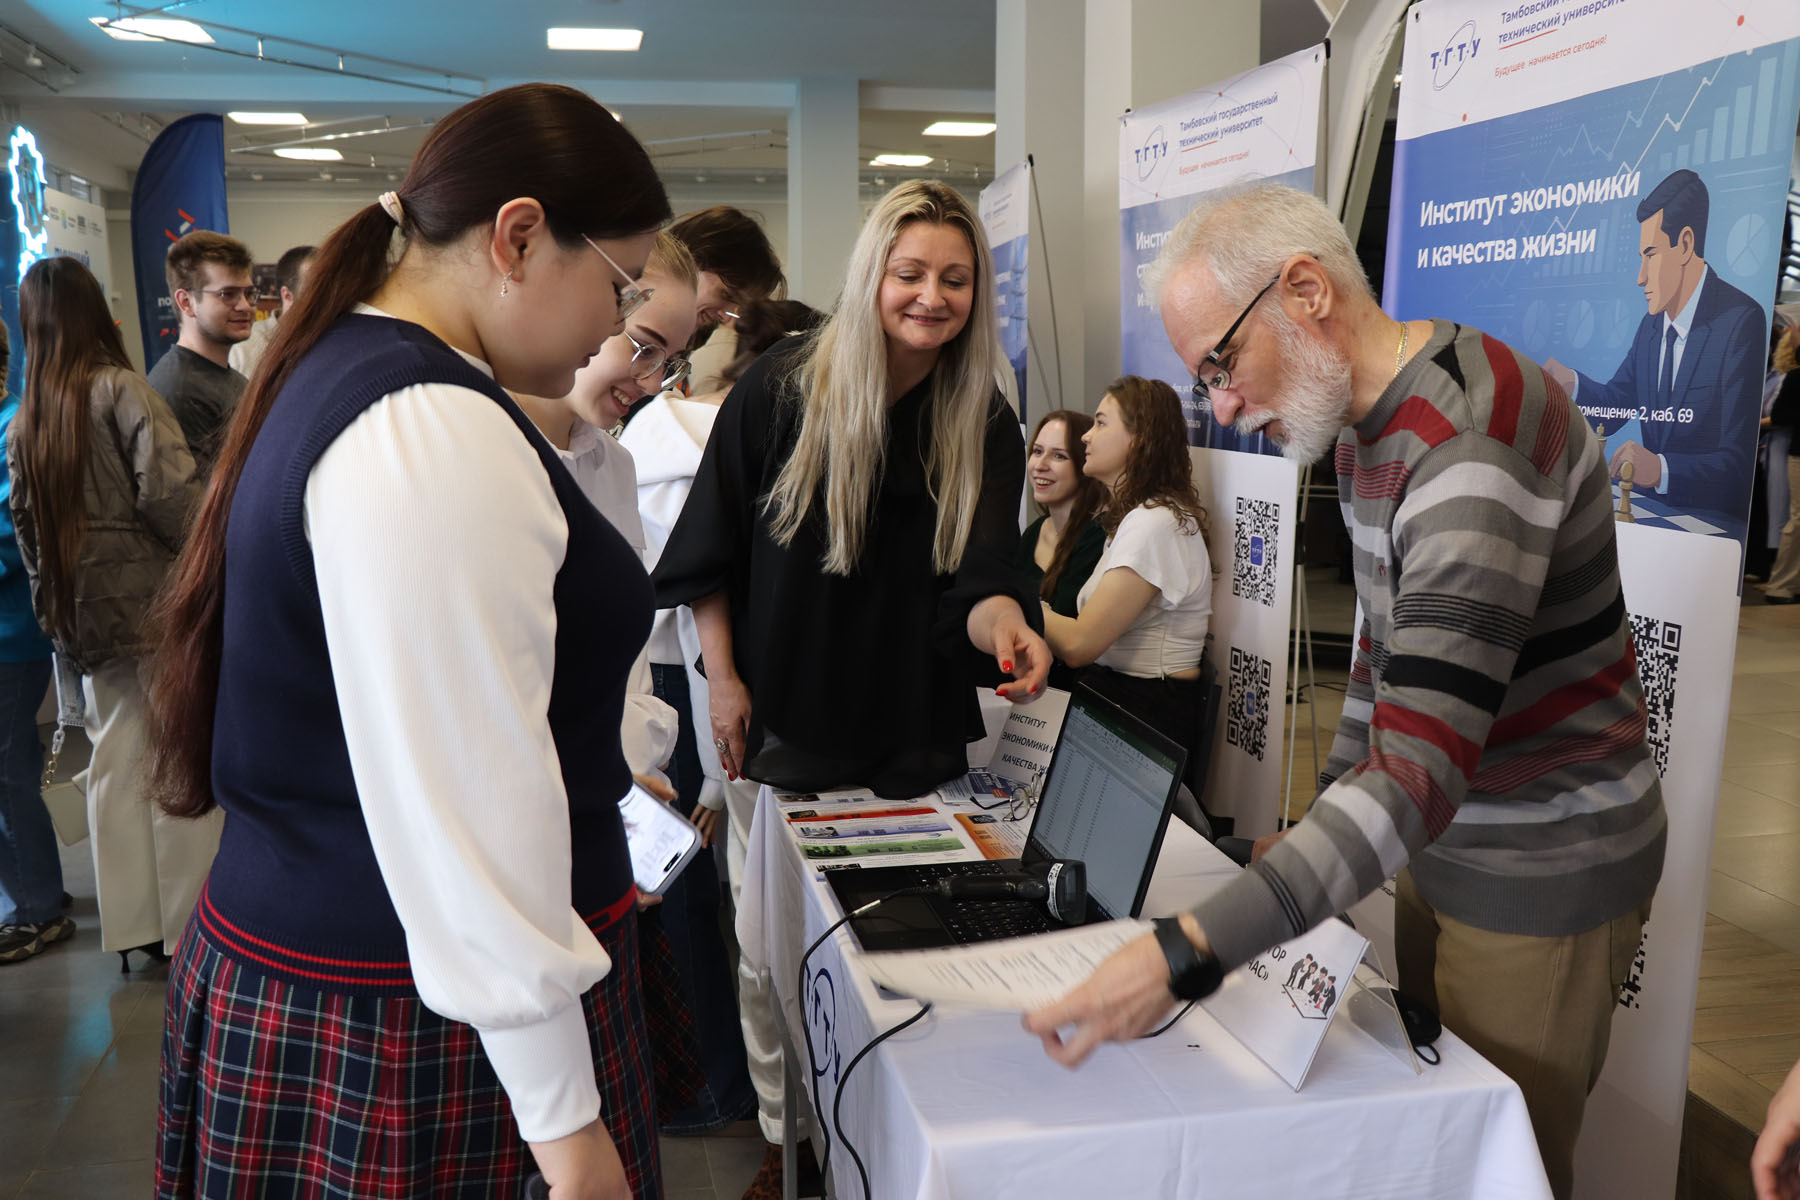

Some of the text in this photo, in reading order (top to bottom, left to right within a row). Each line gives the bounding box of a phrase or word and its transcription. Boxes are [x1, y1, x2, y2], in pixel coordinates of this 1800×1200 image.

[1498, 0, 1625, 44] технический универси
[1573, 34, 1608, 54] сегодня!
[1420, 171, 1641, 227] Институт экономики
[1136, 230, 1170, 251] Инсти
[1417, 228, 1597, 269] и качества жизни
[1577, 405, 1694, 423] омещение 2, каб. 69
[1009, 712, 1047, 729] ИНСТИТУТ
[1001, 731, 1049, 753] ЭКОНОМИКИ
[1002, 753, 1038, 772] КАЧЕСТВА
